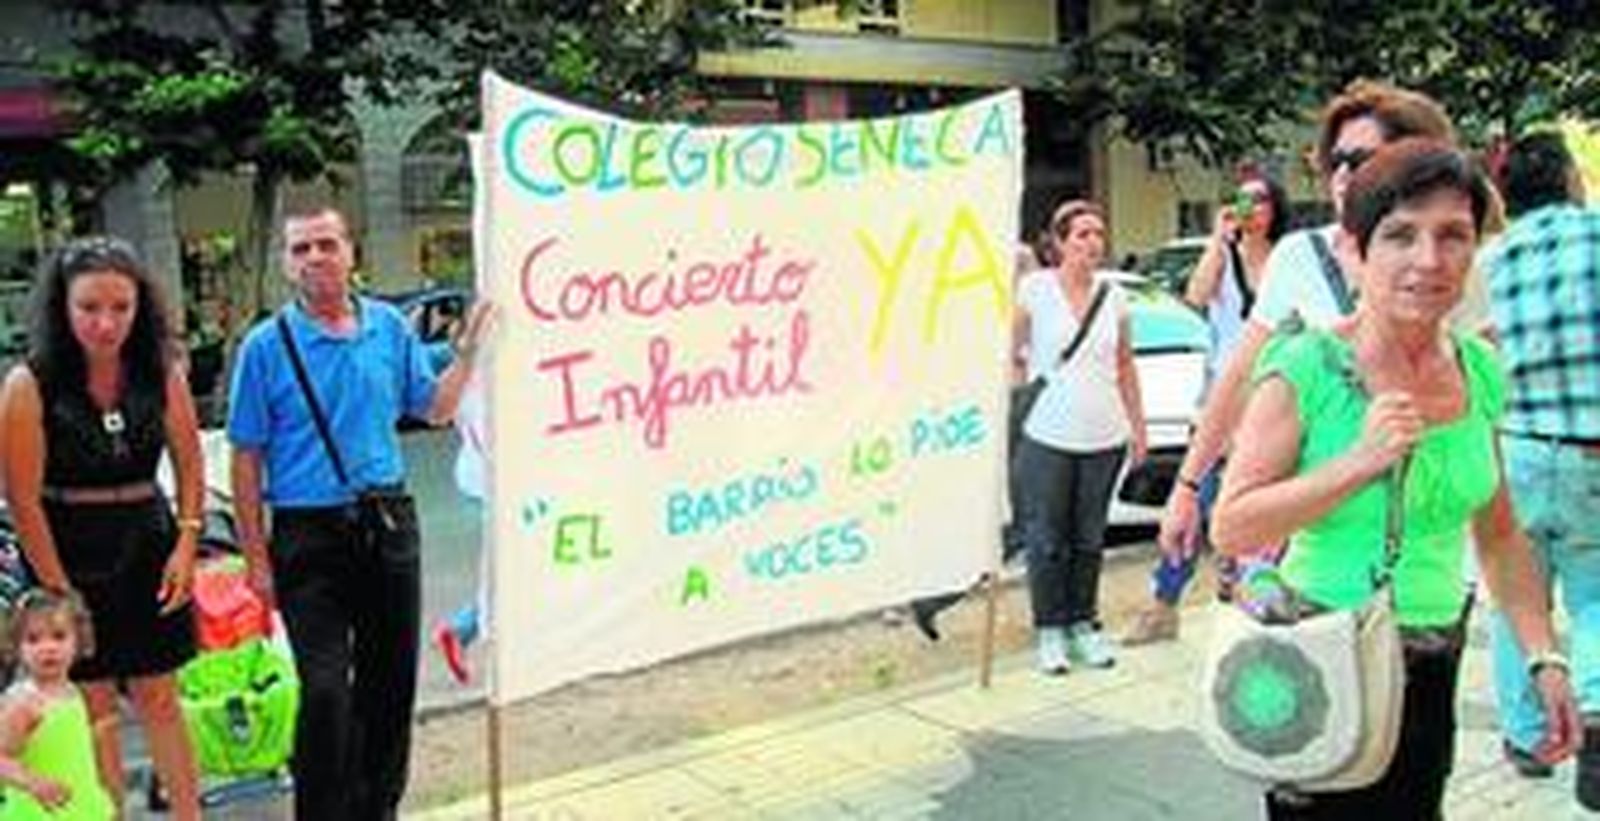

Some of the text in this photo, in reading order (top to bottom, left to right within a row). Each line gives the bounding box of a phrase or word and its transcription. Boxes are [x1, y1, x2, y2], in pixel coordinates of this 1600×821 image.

[502, 107, 784, 195] COLEGIO
[519, 233, 816, 321] Concierto
[852, 204, 1011, 357] YA
[535, 309, 813, 448] Infantil
[681, 570, 709, 605] A
